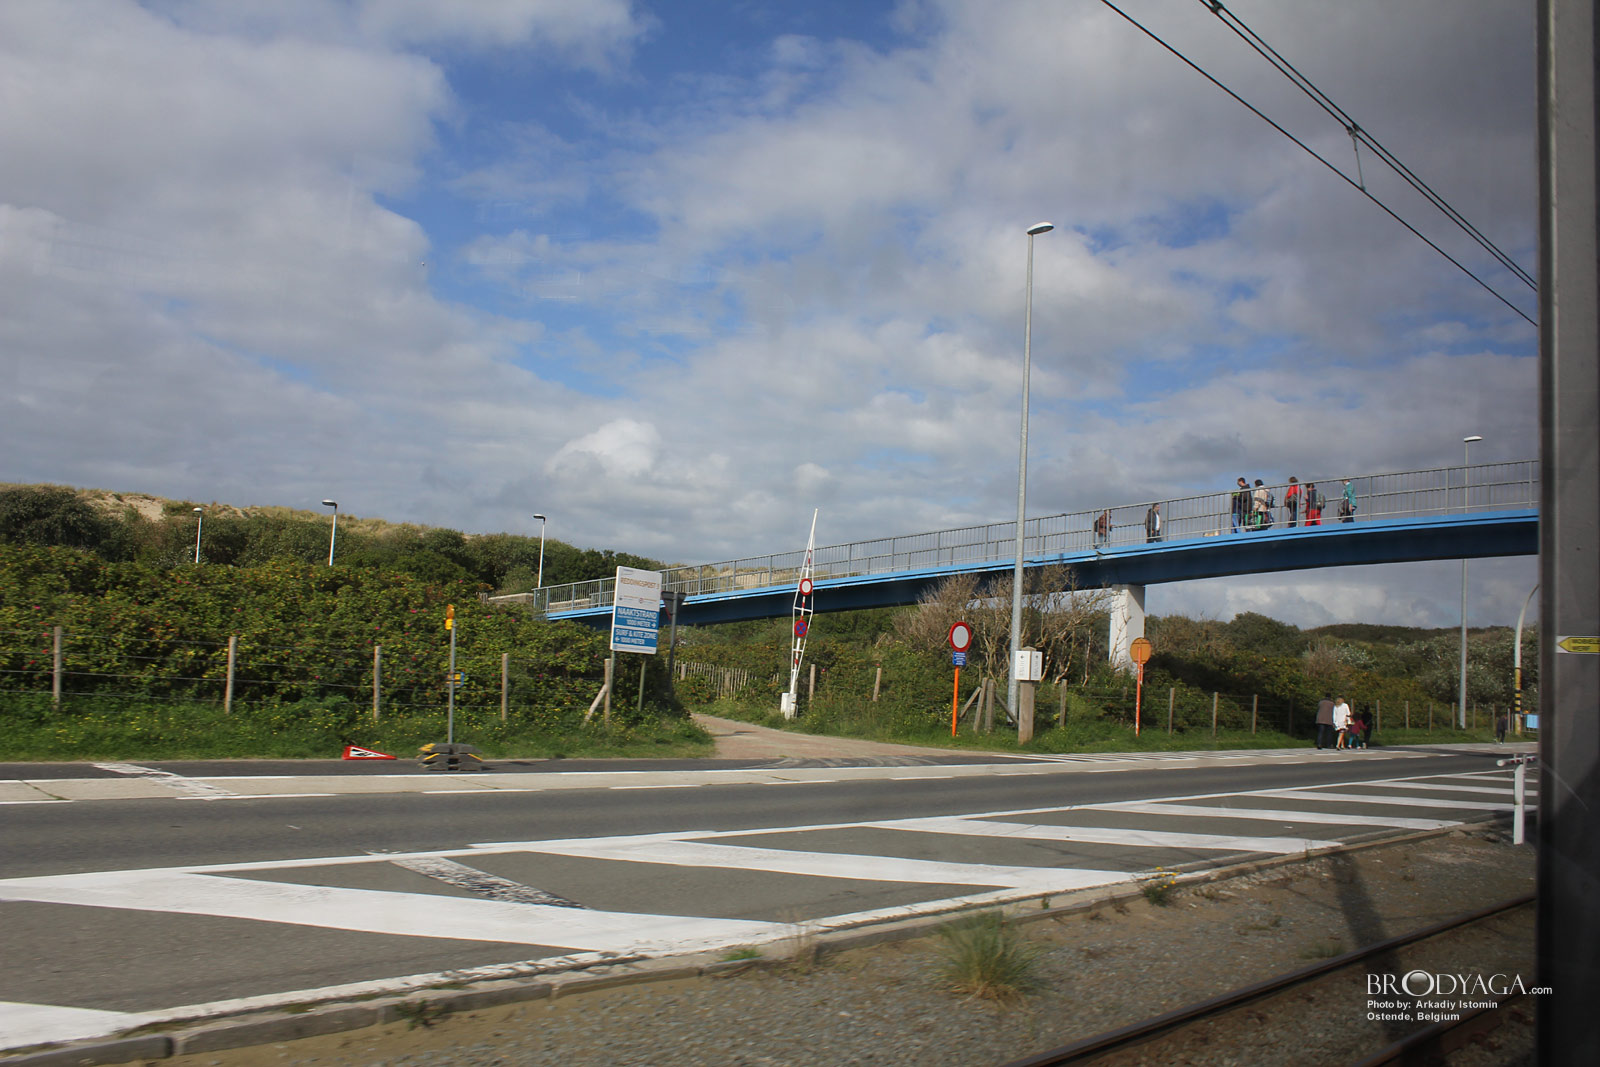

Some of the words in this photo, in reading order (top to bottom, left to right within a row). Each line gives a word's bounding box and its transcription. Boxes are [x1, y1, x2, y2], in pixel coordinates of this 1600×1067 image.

[617, 607, 657, 619] NAAKTSTRAND
[637, 620, 651, 628] METER
[616, 628, 629, 636] SURF
[643, 631, 657, 640] ZONE
